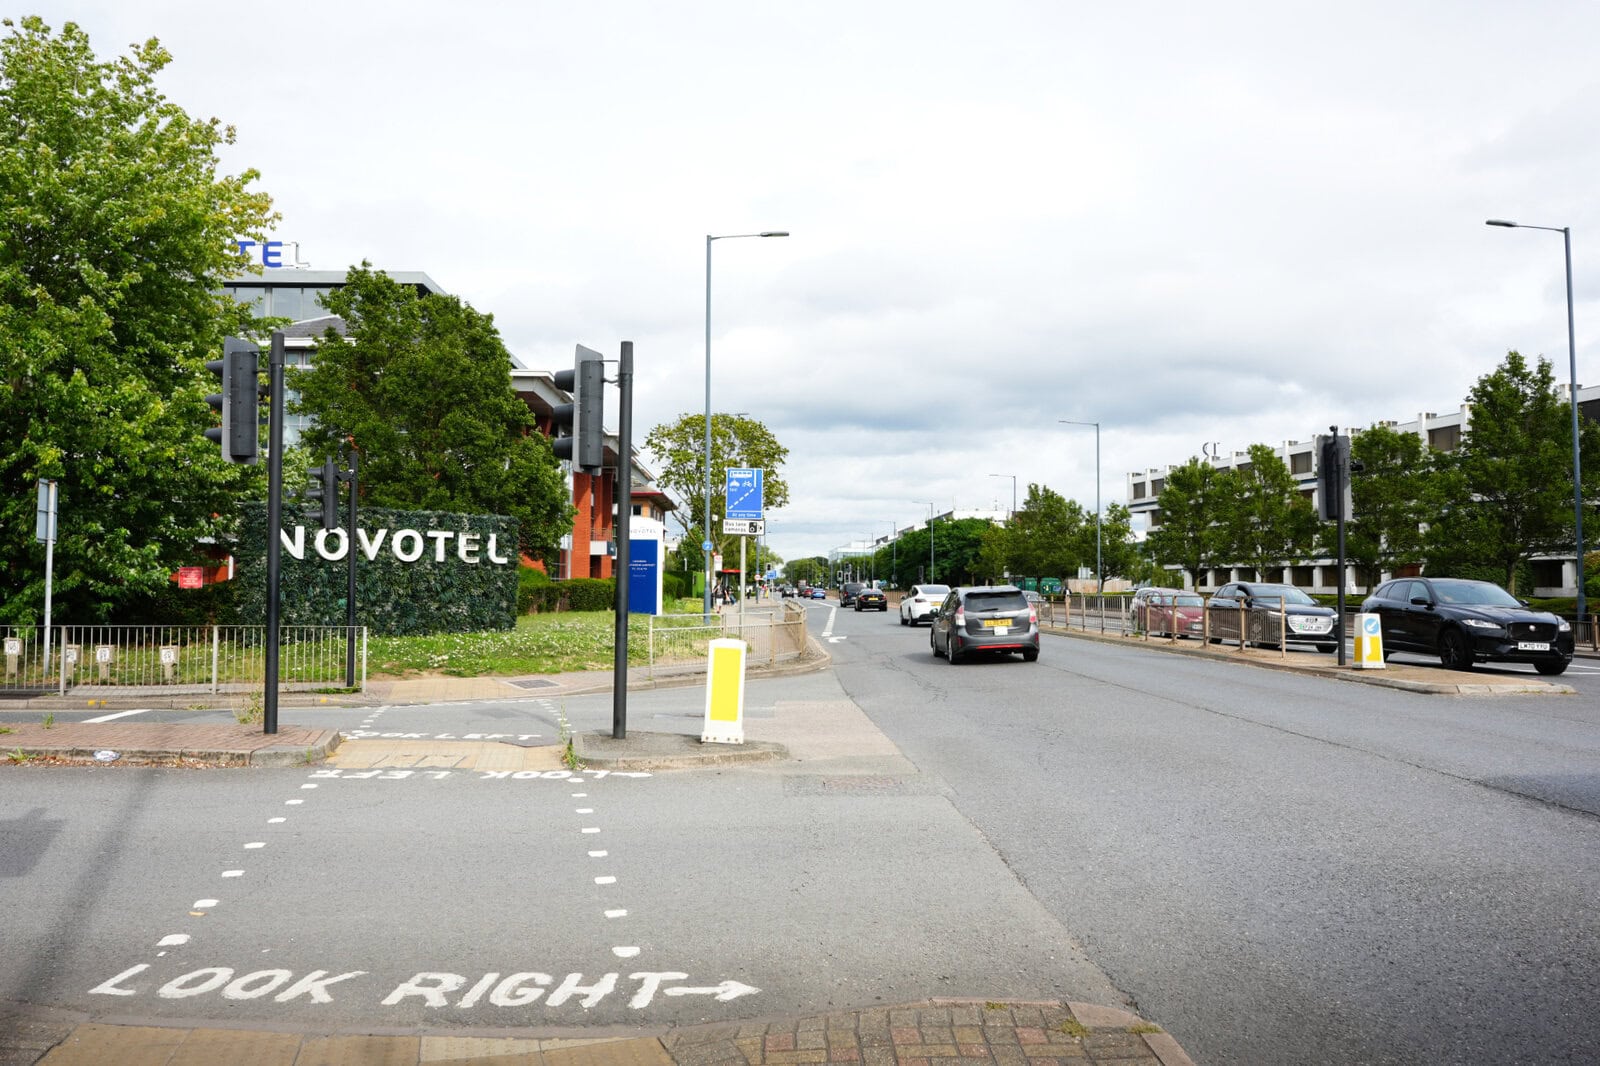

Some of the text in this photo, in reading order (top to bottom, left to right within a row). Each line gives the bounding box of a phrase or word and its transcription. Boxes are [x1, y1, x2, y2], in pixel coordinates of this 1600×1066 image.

[281, 526, 508, 564] NOVOTEL
[434, 732, 542, 740] LEFT
[87, 963, 689, 1009] LOOK RIGHT
